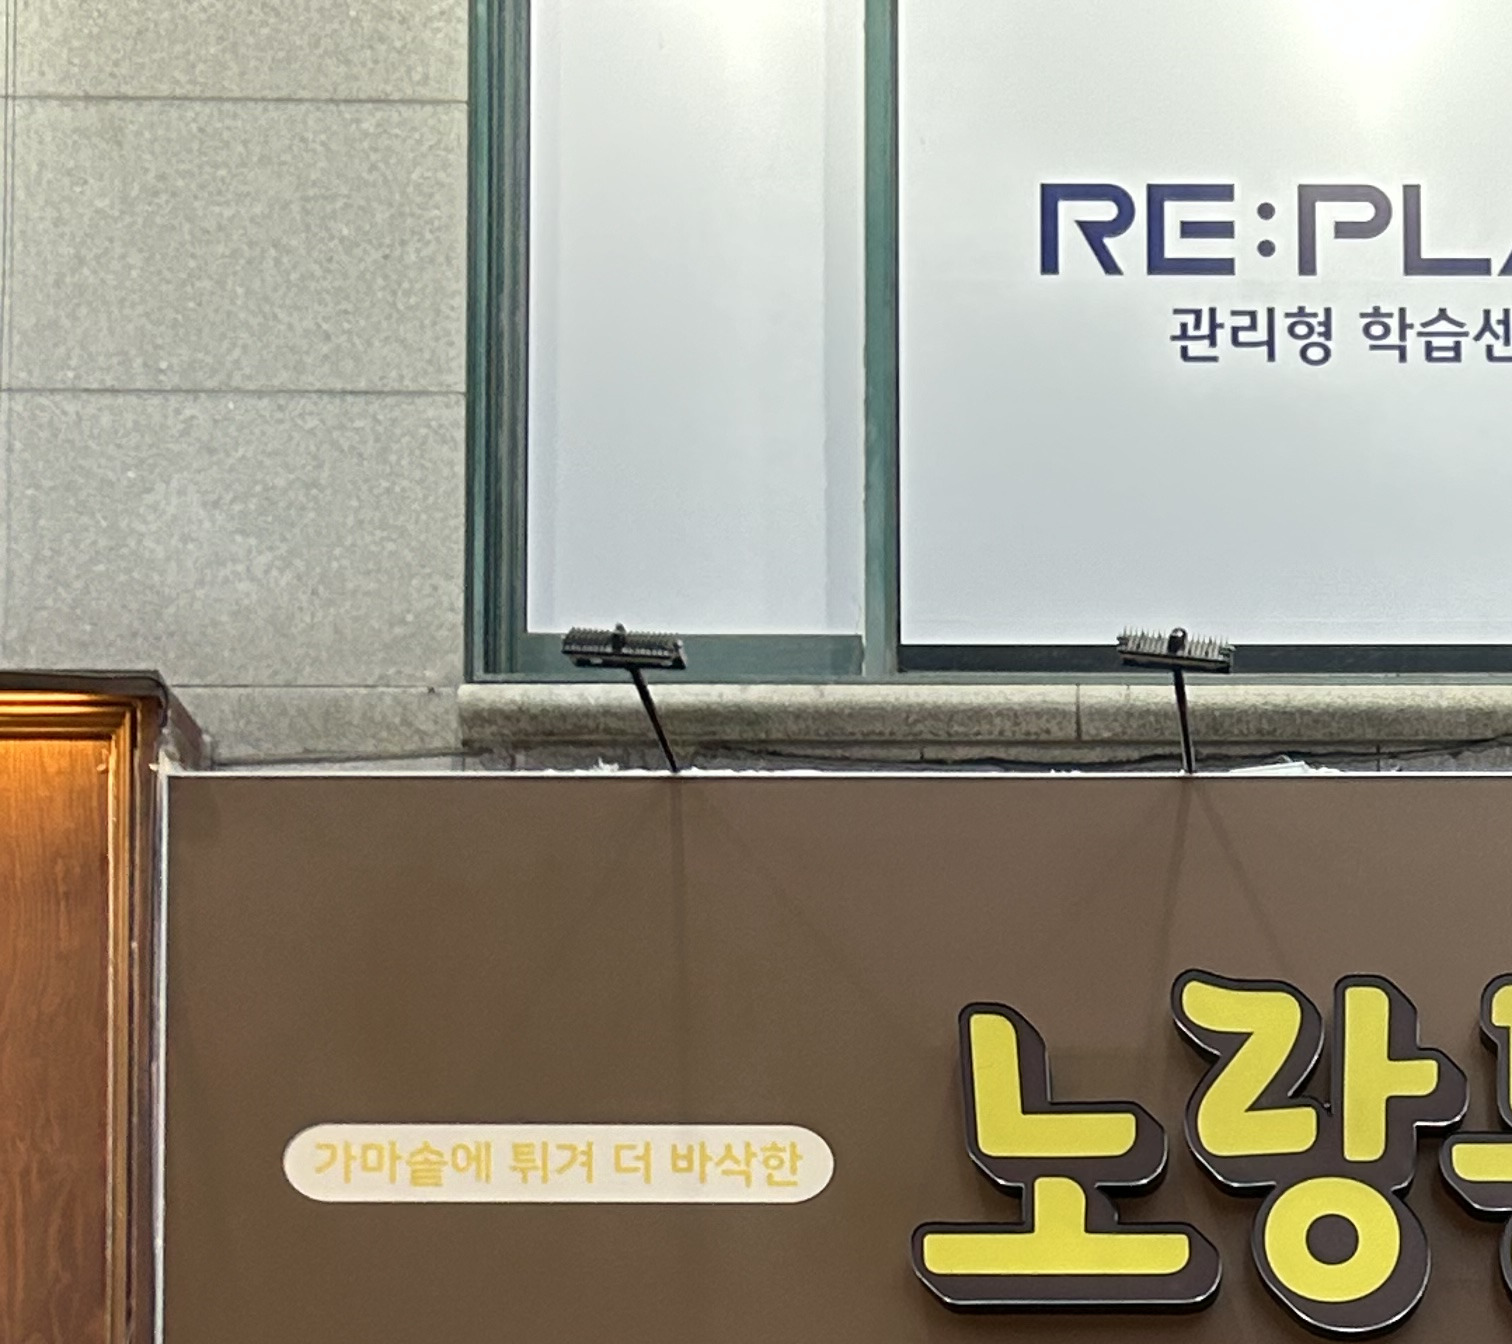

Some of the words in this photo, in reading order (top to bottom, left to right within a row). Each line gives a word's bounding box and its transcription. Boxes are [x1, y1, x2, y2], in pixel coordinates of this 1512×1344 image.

[1169, 304, 1333, 367] 관리형
[313, 1140, 492, 1189] 가마솥에
[510, 1140, 595, 1185] 튀겨
[613, 1140, 654, 1183] 더
[670, 1139, 802, 1188] 바삭한
